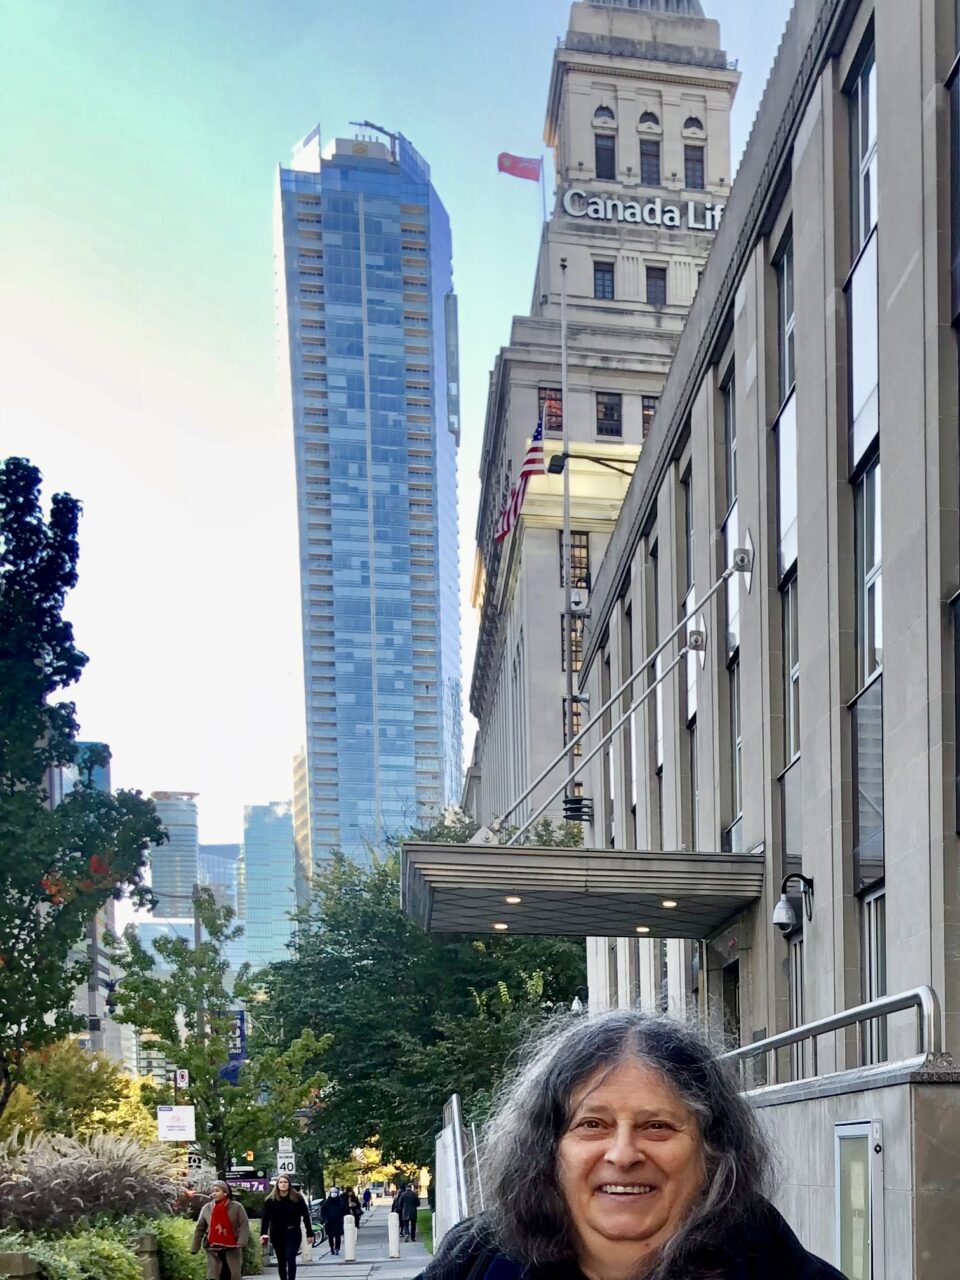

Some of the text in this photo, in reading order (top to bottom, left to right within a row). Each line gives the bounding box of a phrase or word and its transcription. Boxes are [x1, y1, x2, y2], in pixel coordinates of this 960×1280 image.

[563, 188, 725, 231] Canada Lif
[279, 1162, 294, 1172] 40
